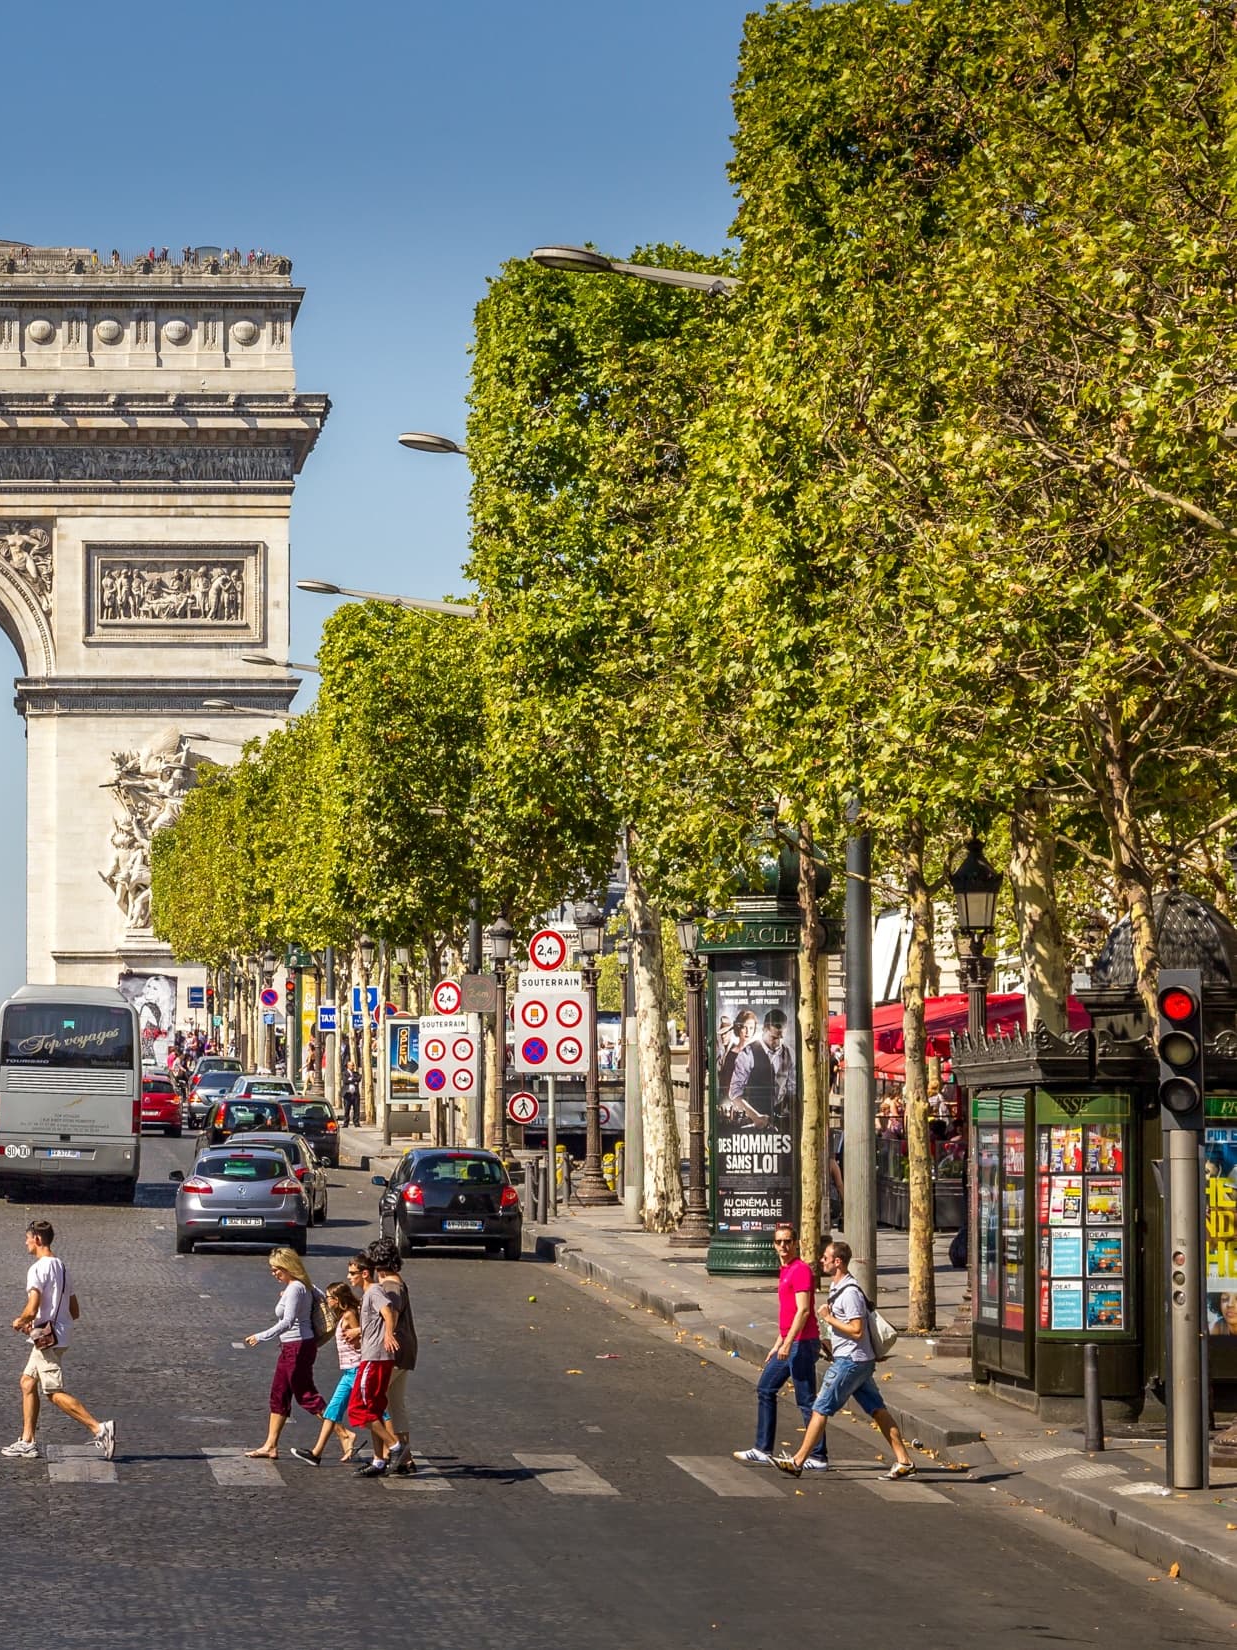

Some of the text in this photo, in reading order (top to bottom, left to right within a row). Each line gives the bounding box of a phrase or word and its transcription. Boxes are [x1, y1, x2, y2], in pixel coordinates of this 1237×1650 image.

[701, 926, 797, 944] TACLE
[521, 978, 580, 987] SOUTERRAIN
[421, 1020, 465, 1029] SOUTERRAIN
[17, 1032, 61, 1055] Top
[63, 1028, 120, 1049] voyages
[399, 1029, 408, 1066] OPEN
[719, 1133, 792, 1154] DES HOMMES
[725, 1154, 779, 1174] SANS LOI
[723, 1196, 783, 1207] AU CINÉMA LE
[1205, 1177, 1237, 1208] HE
[723, 1208, 783, 1217] 12 SEPTEMBRE
